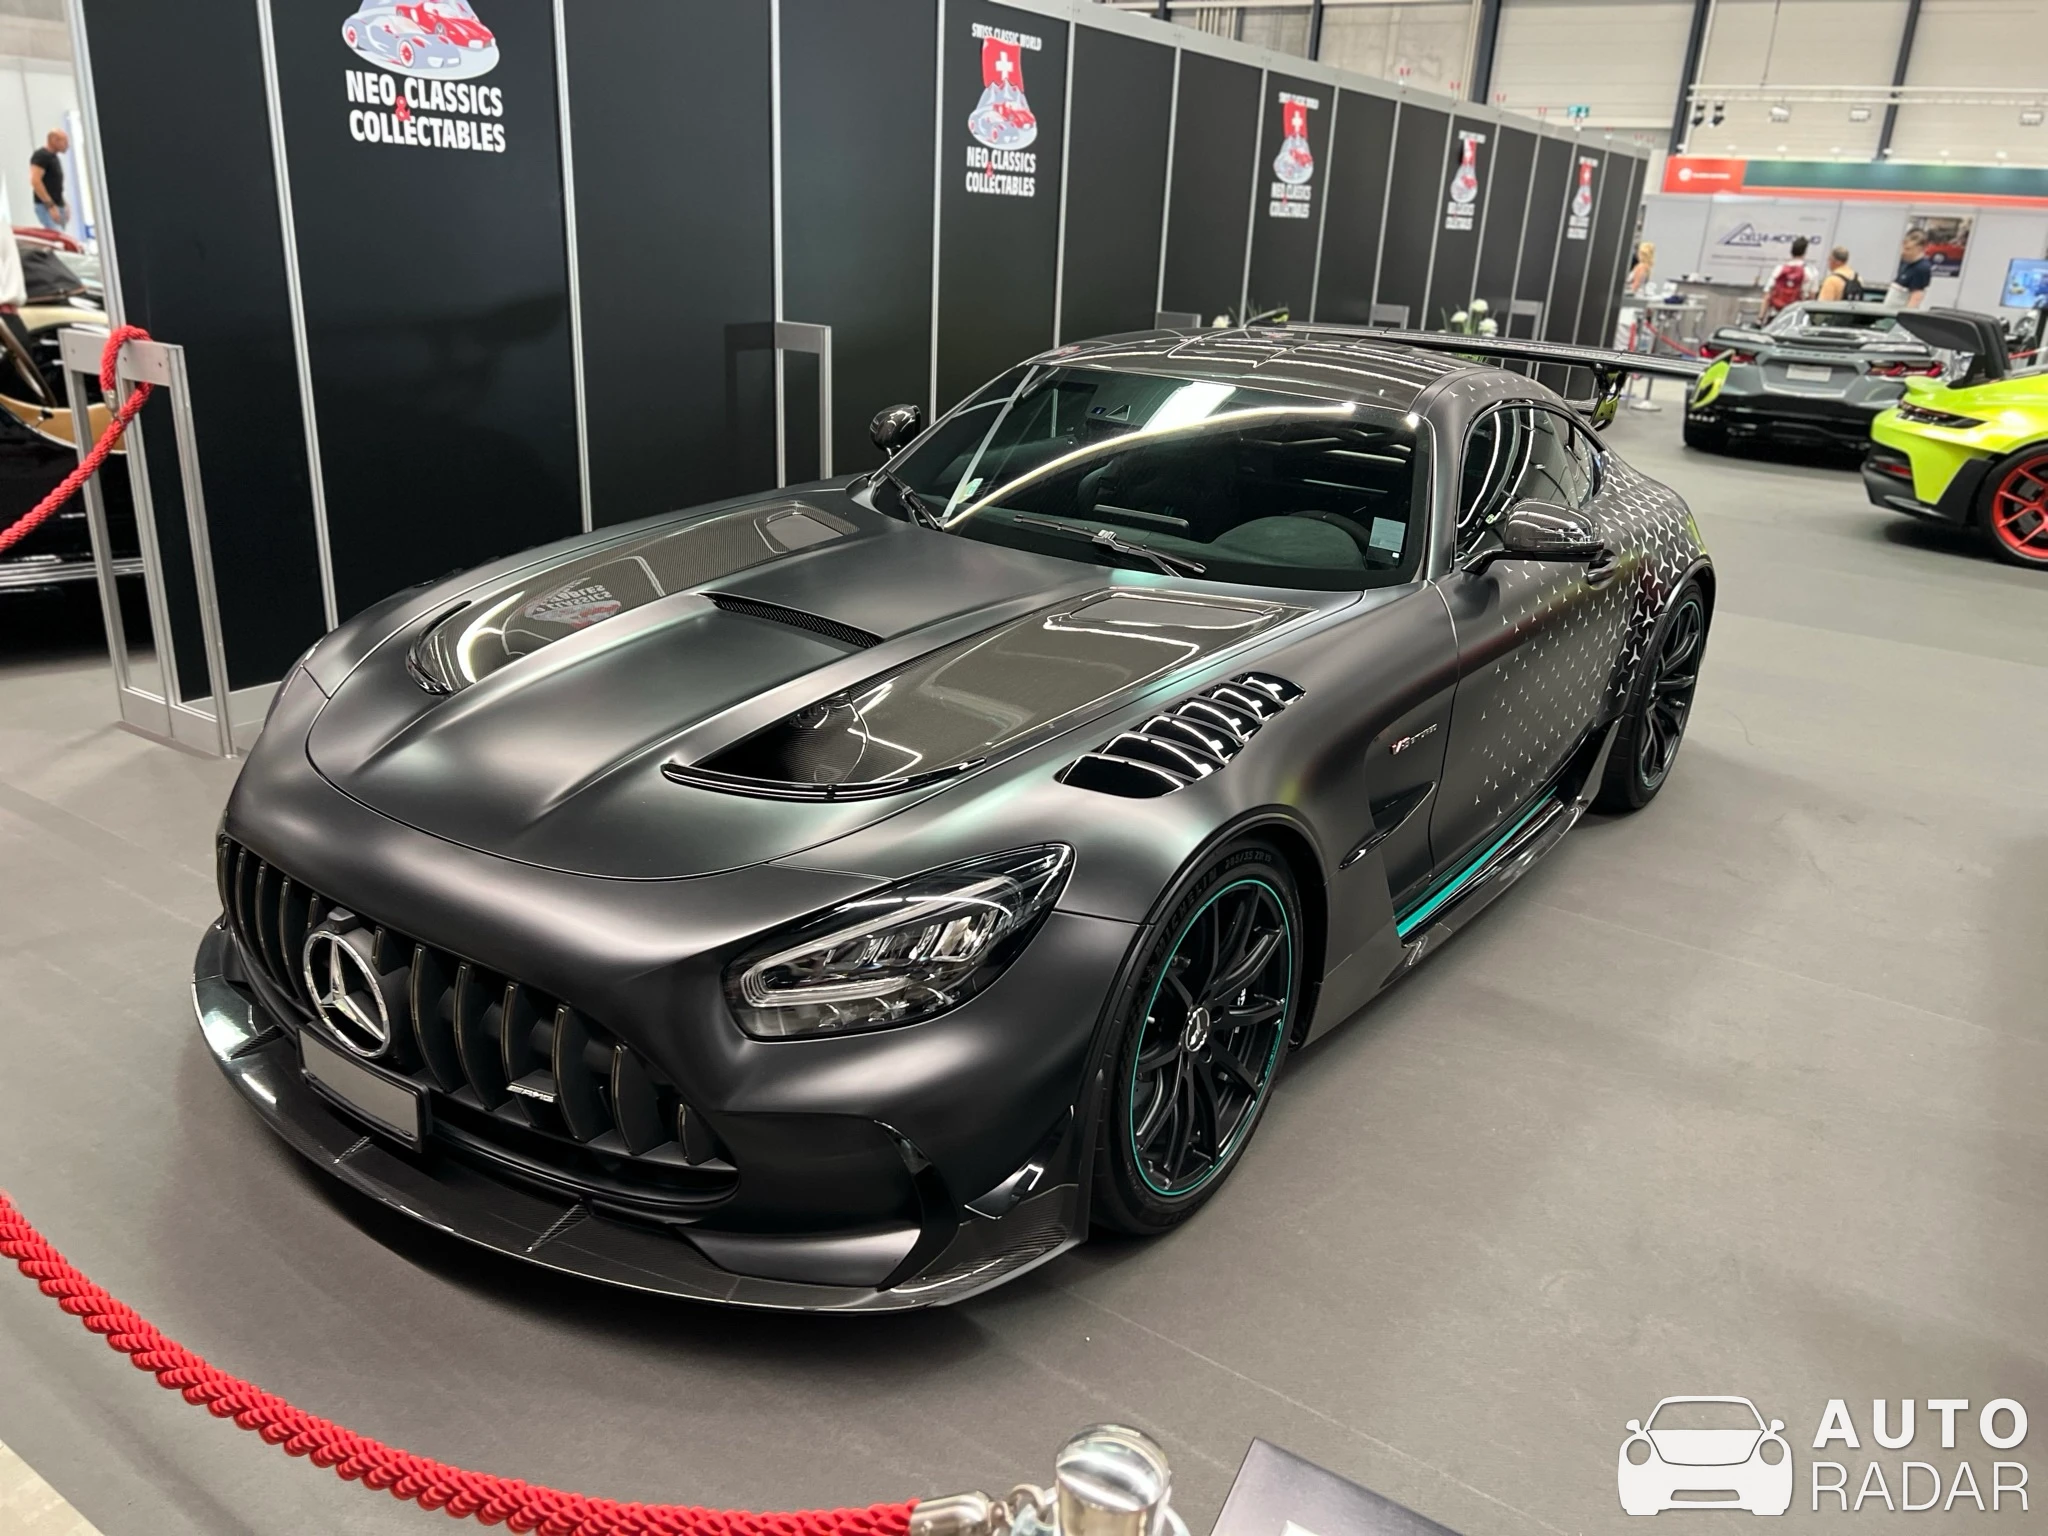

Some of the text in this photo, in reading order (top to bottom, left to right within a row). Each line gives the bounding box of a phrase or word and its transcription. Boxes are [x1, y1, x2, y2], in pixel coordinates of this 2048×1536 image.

[1019, 33, 1042, 51] WORLD
[345, 69, 504, 118] NEO CLASSICS
[395, 95, 412, 122] &
[349, 109, 507, 153] COLLECTABLES
[966, 145, 1036, 174] NEO CLASSICS
[965, 171, 1036, 198] COLLECTABLES
[1390, 736, 1410, 755] V8
[1155, 867, 1218, 959] MICHELIN
